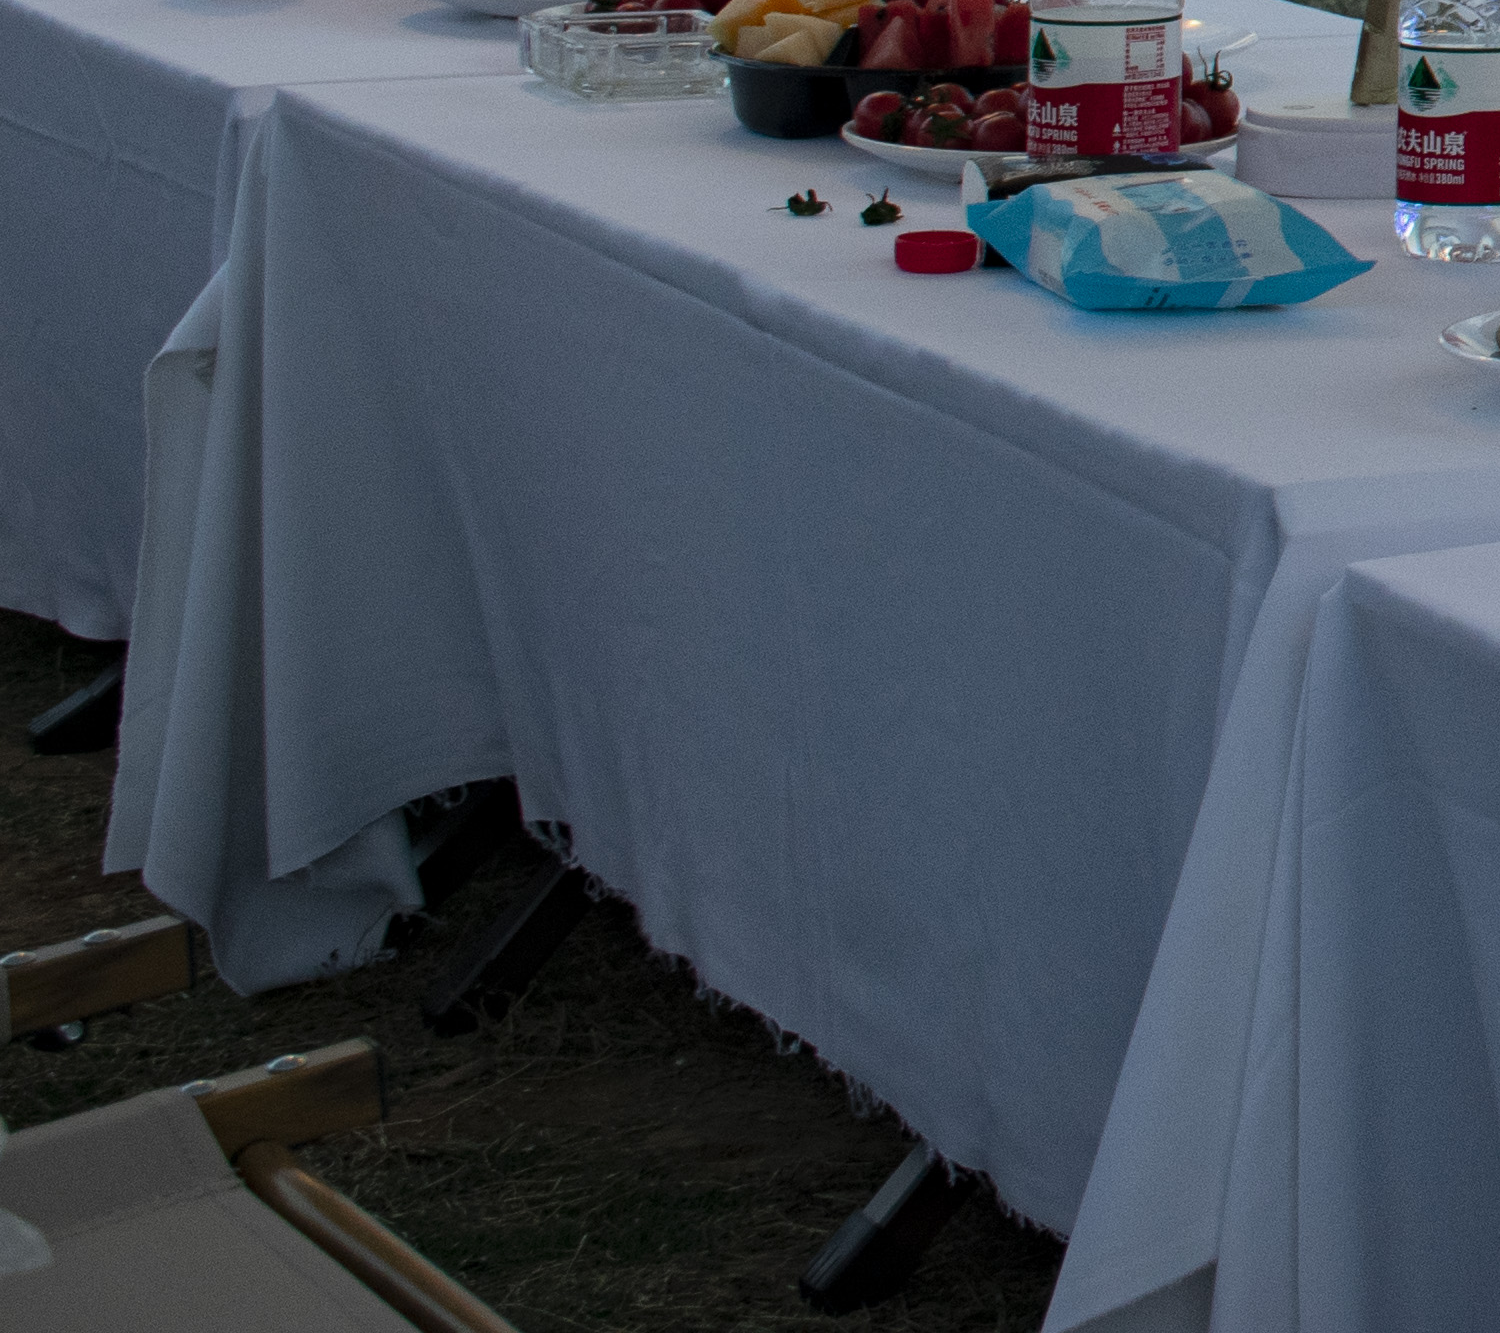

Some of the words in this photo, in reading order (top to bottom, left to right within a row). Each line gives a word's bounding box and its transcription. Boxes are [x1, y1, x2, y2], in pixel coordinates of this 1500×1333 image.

[1027, 99, 1079, 127] 夫山泉
[1042, 128, 1078, 142] SPRING
[1423, 157, 1465, 171] SPRING
